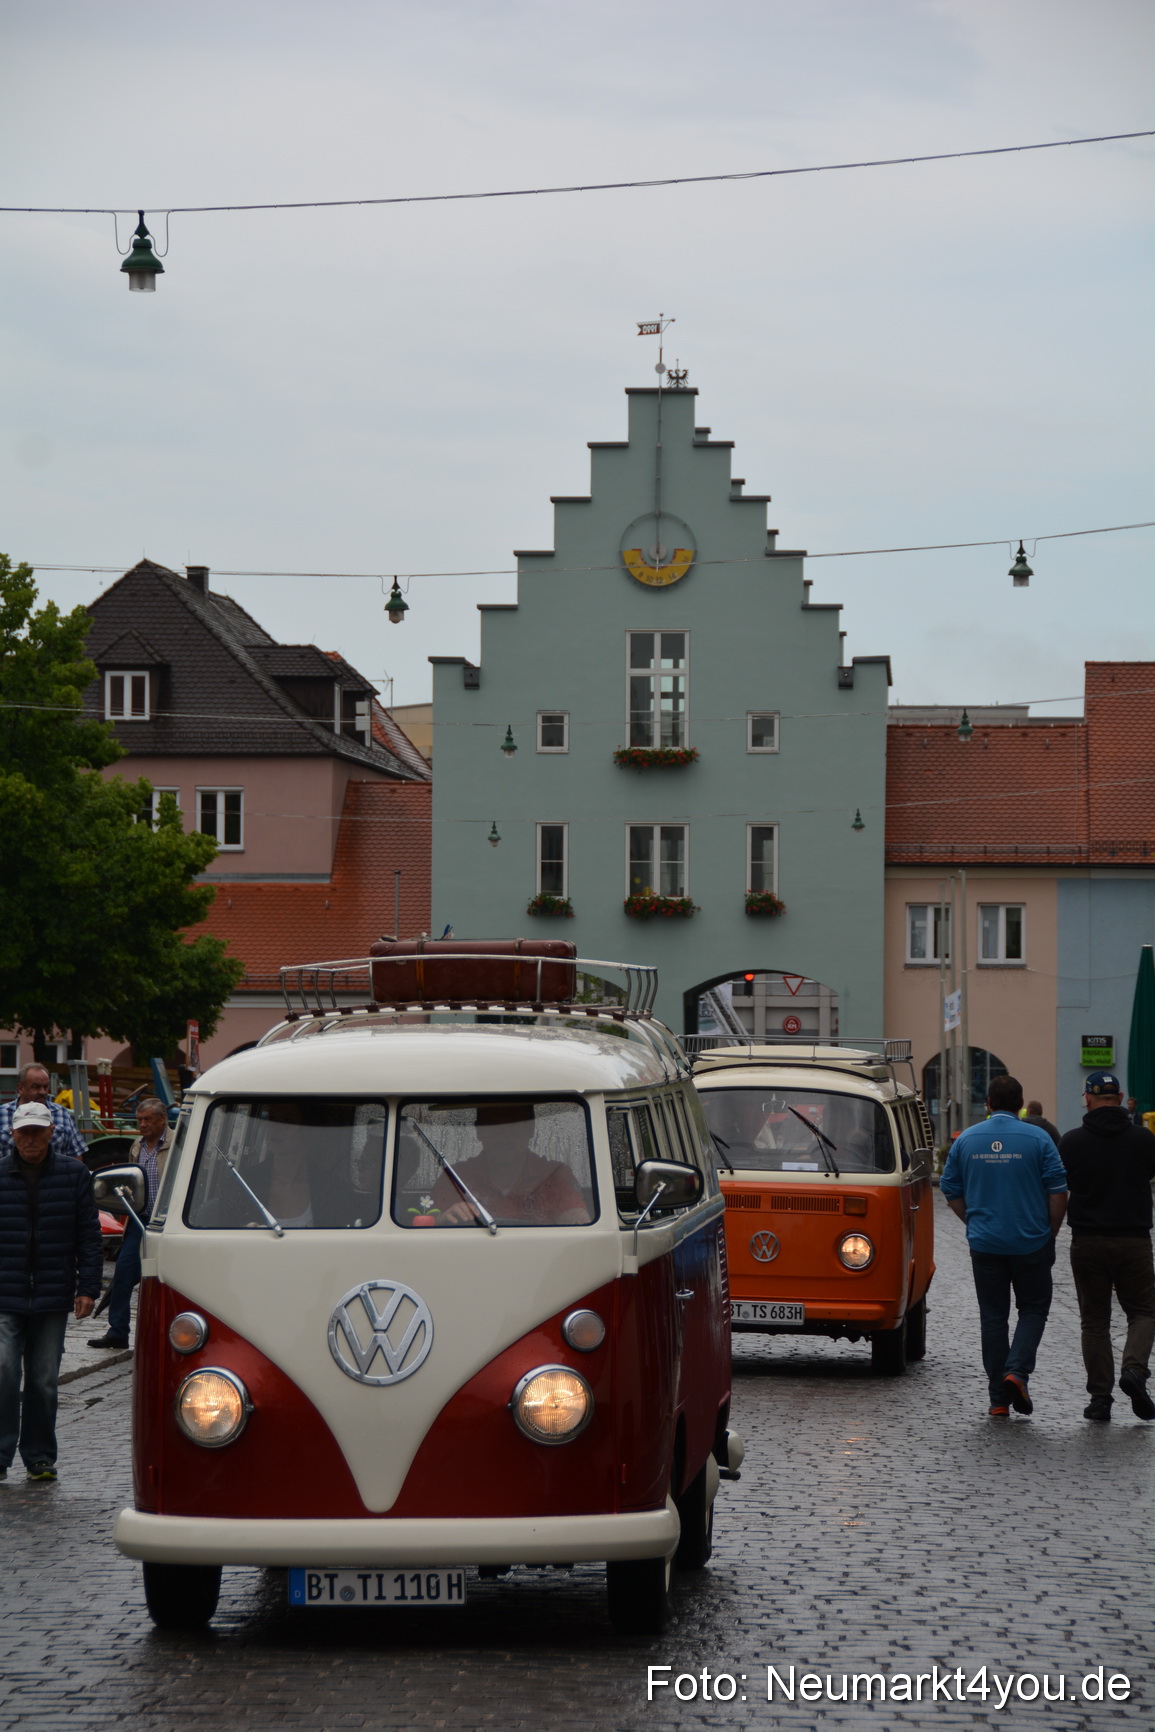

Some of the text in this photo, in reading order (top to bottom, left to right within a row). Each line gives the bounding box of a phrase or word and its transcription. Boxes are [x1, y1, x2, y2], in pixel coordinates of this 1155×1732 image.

[751, 1231, 781, 1262] VW
[751, 1305, 767, 1319] TS
[327, 1279, 434, 1386] VW
[307, 1573, 339, 1601] BT
